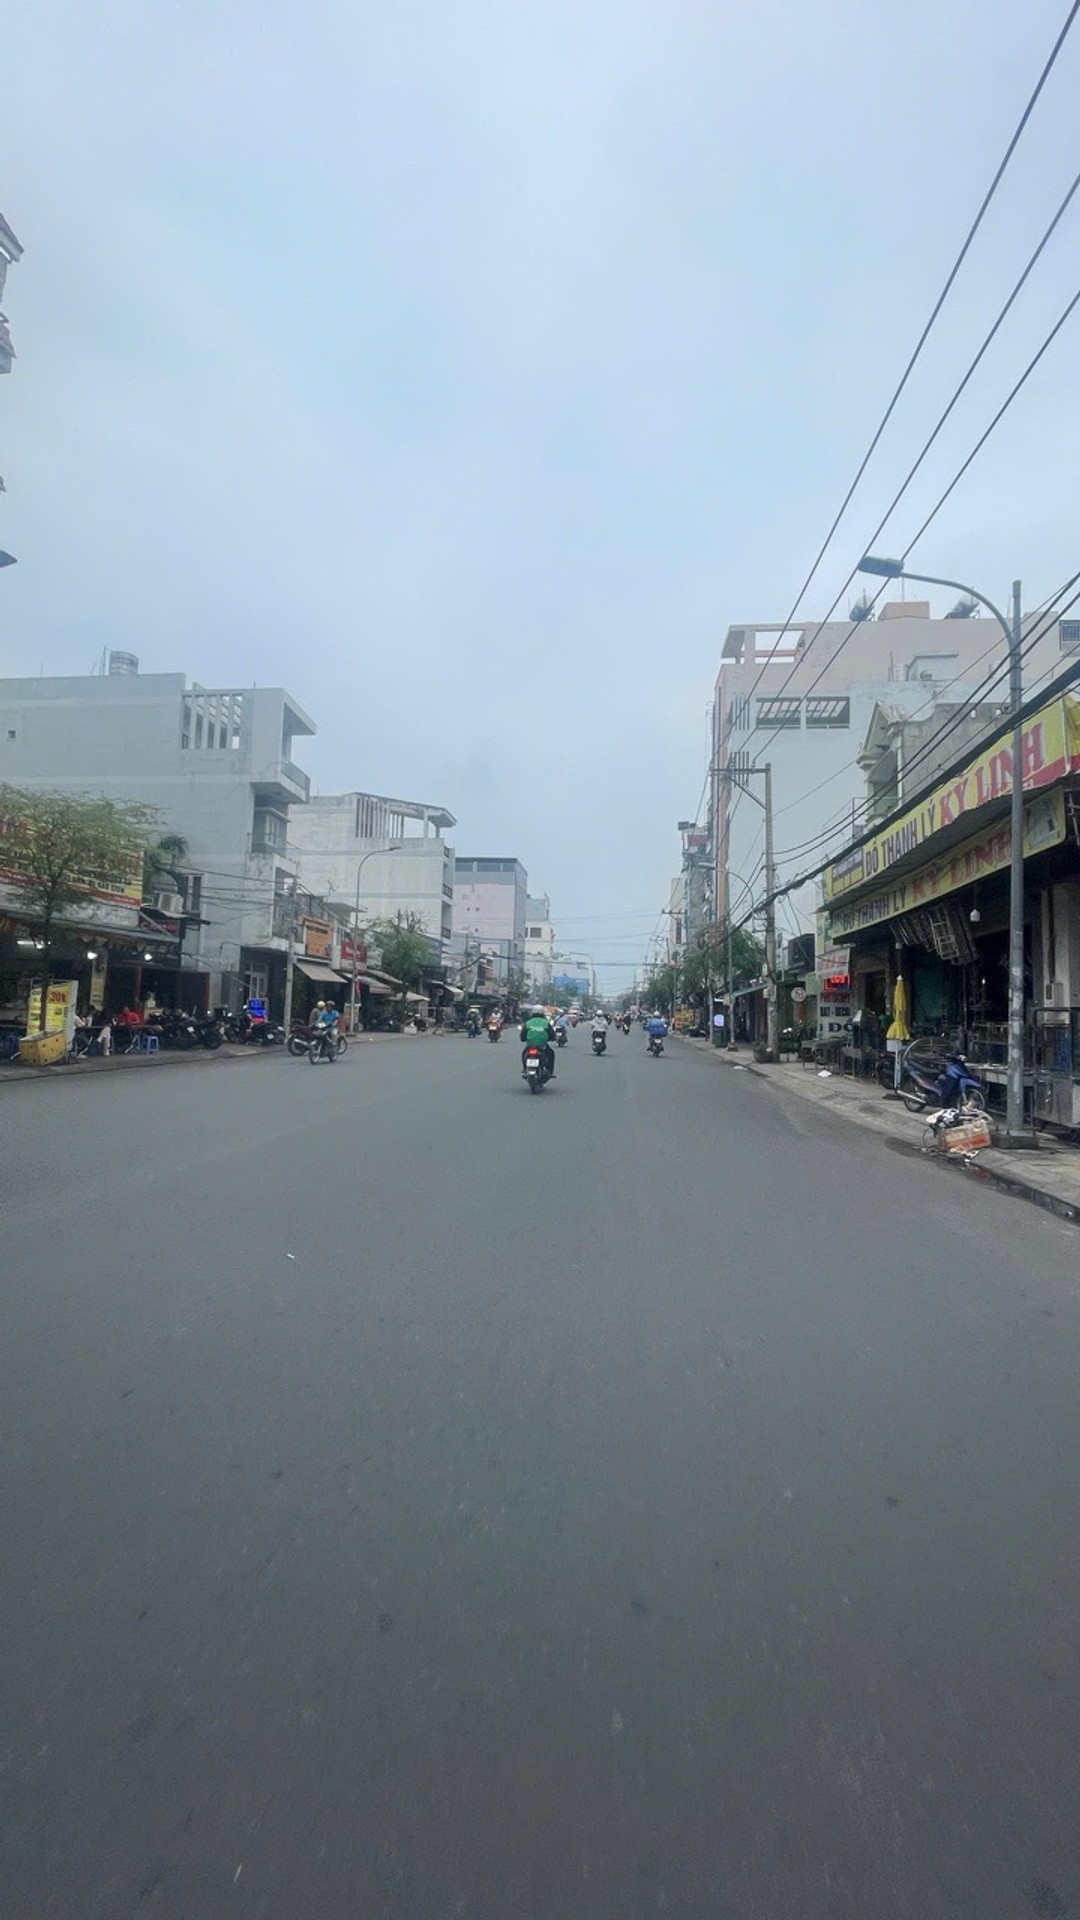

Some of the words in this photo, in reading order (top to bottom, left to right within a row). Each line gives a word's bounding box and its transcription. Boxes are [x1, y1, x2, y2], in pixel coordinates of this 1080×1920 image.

[881, 818, 918, 868] THANH
[921, 799, 936, 840] LÝ
[975, 721, 1046, 806] LINH
